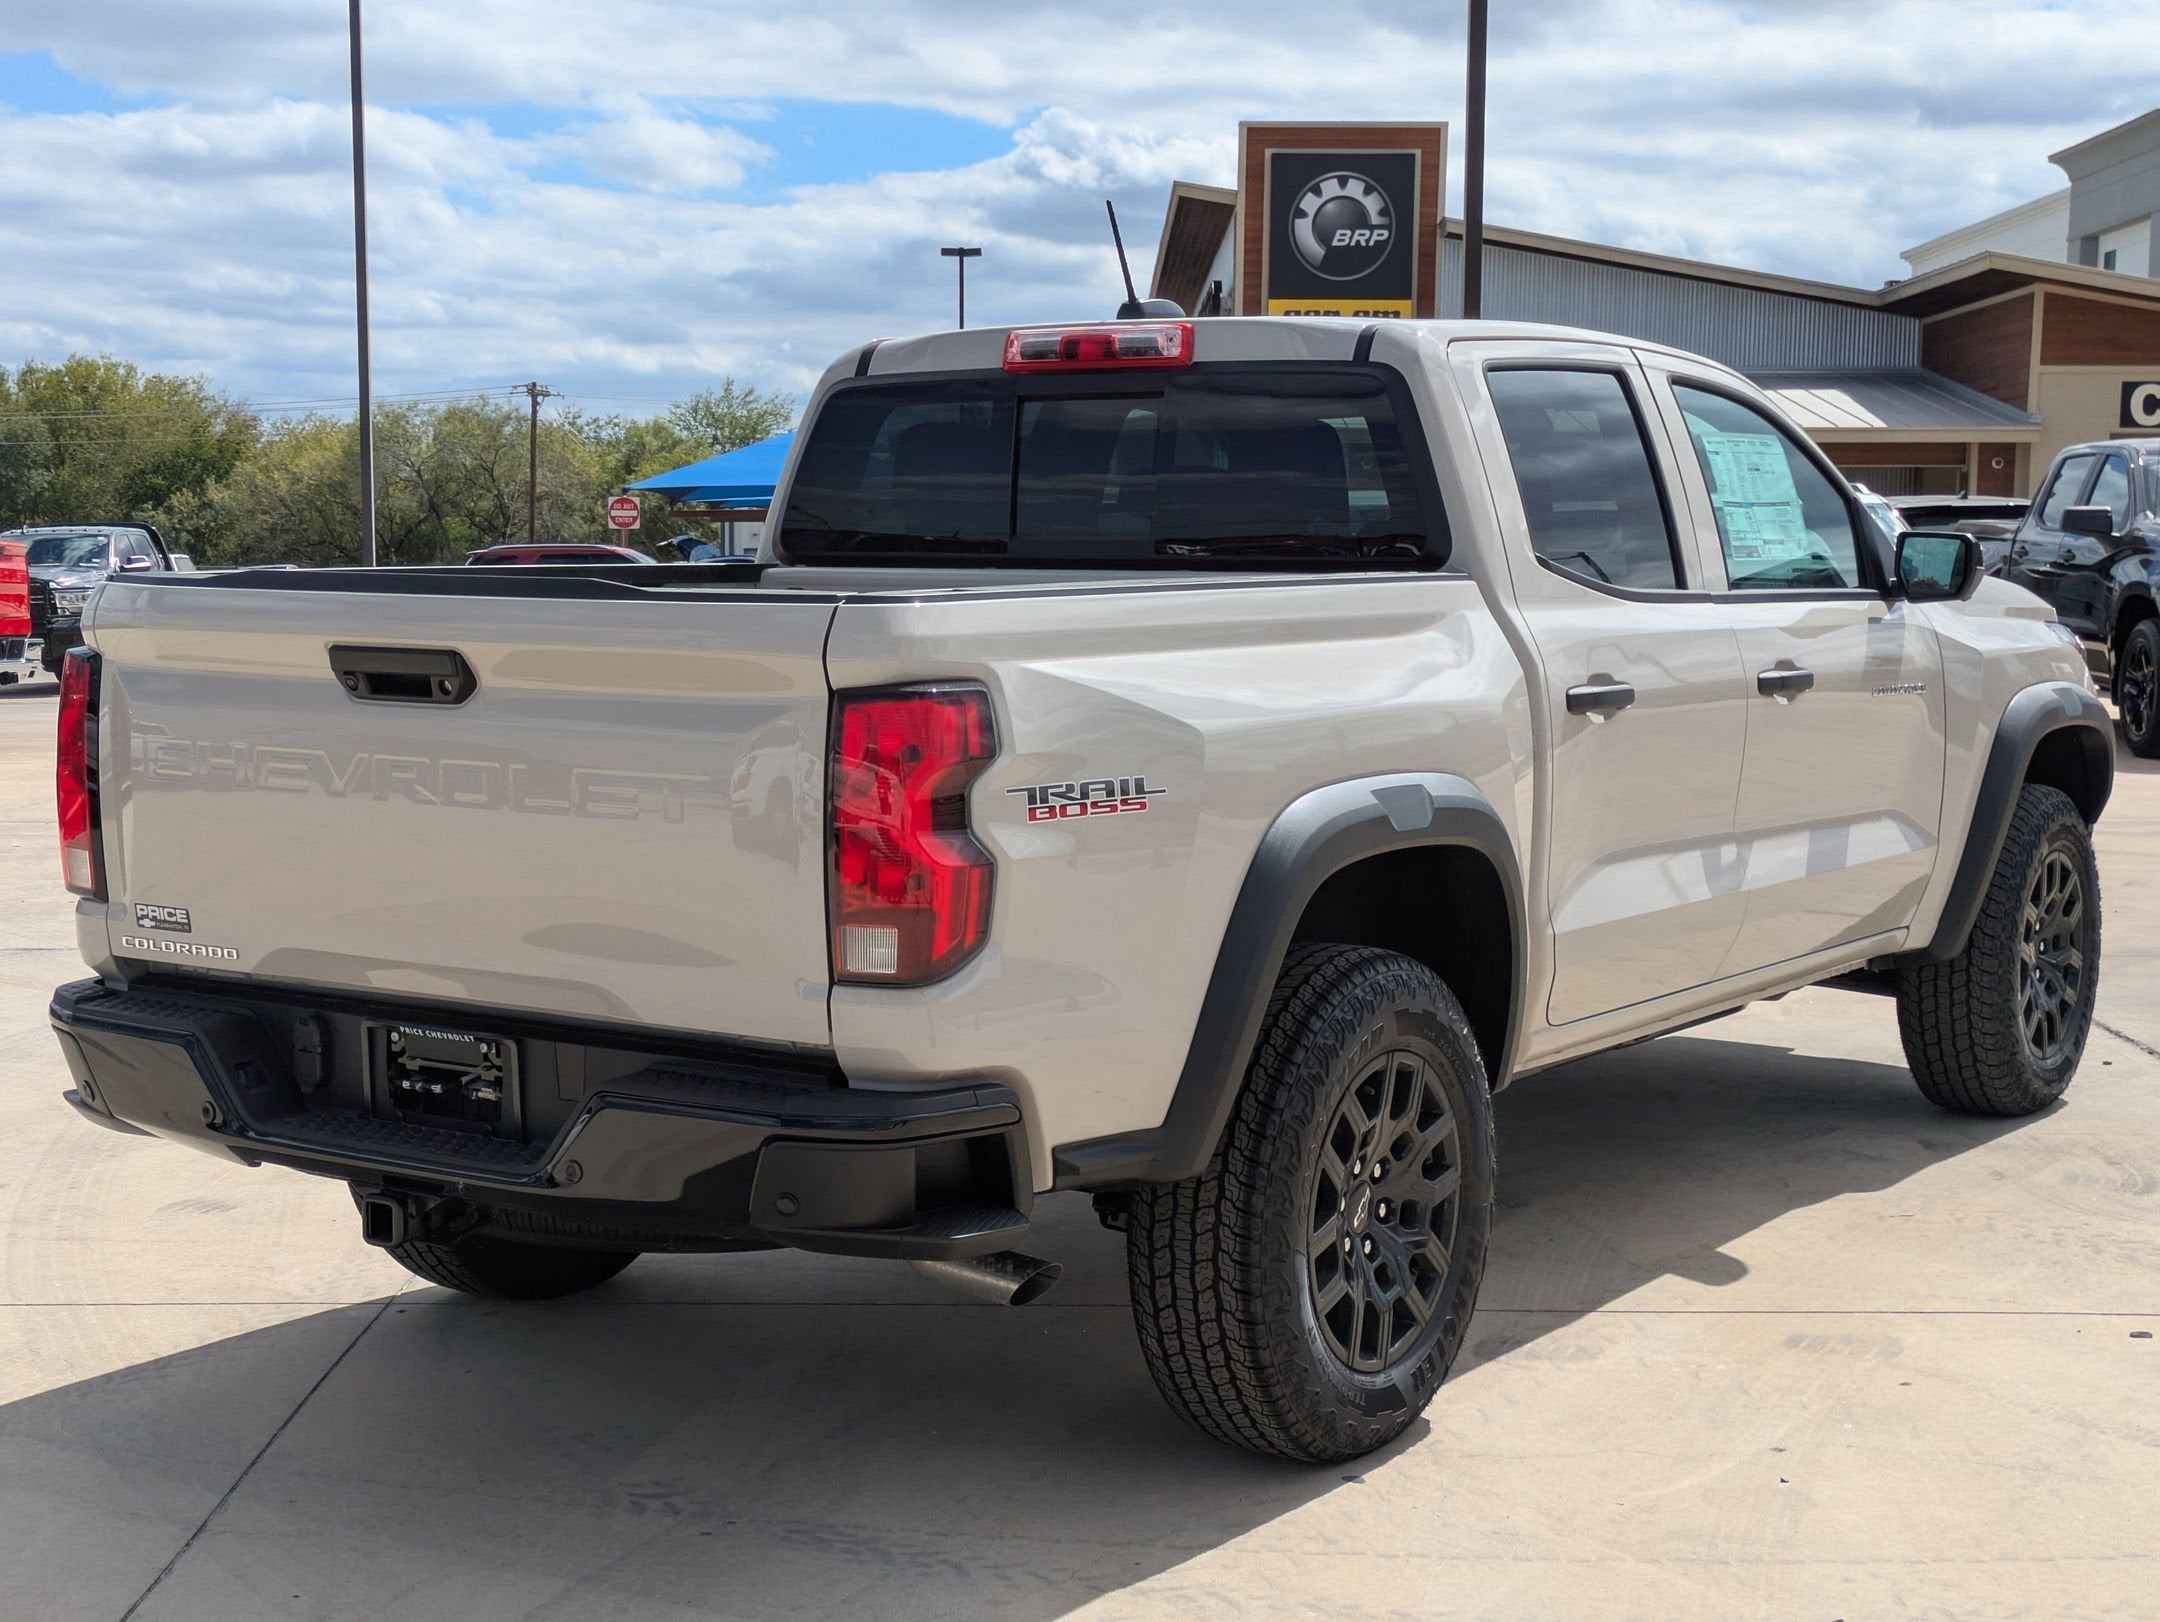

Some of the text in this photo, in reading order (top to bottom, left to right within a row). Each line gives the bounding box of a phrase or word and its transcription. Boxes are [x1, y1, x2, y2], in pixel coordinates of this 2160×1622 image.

[1331, 229, 1389, 247] BRP
[1005, 775, 1167, 807] TRAIL
[1027, 797, 1149, 824] BOSS
[136, 904, 188, 923] PRICE
[122, 936, 238, 960] COLORADO
[400, 1026, 474, 1042] PRICE CHEVROLET
